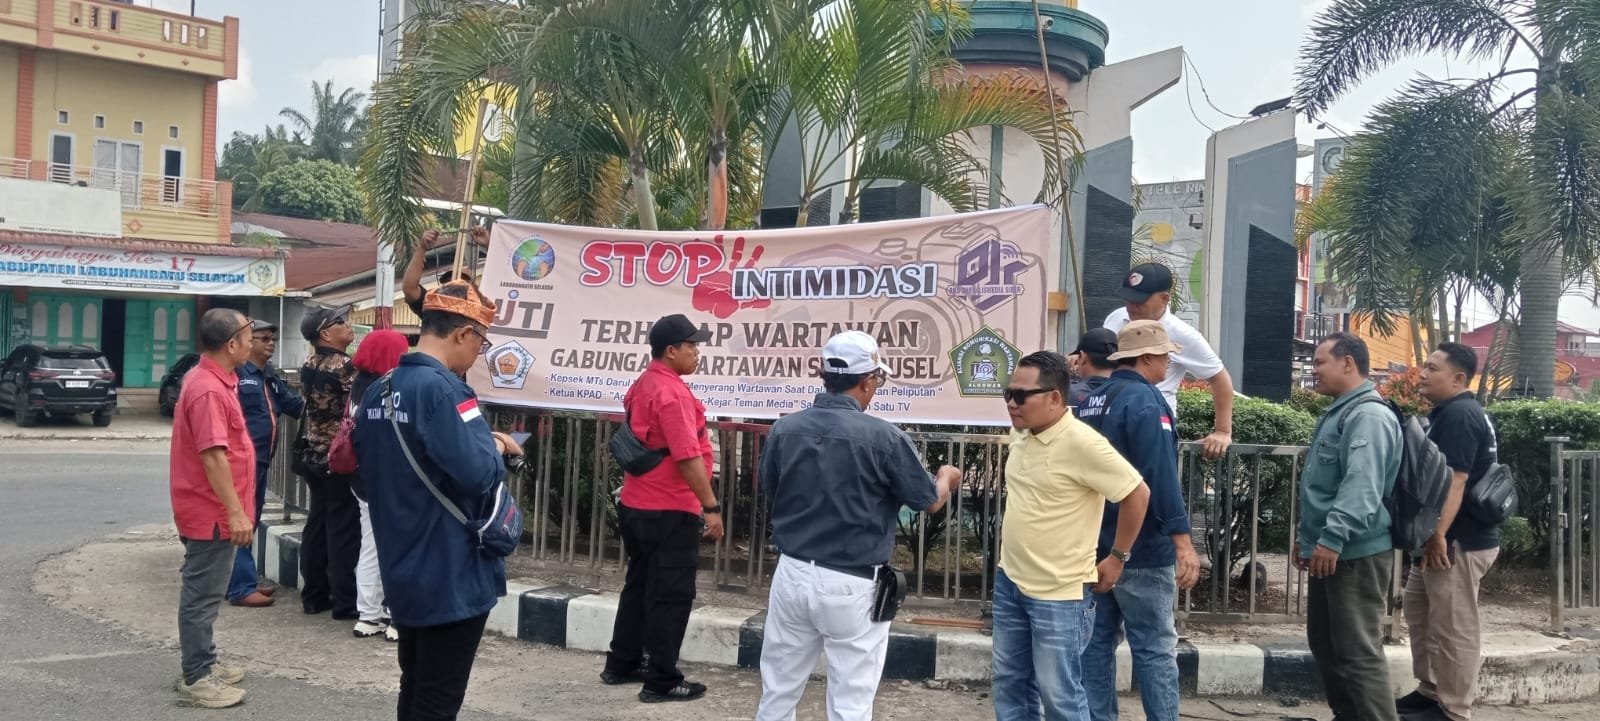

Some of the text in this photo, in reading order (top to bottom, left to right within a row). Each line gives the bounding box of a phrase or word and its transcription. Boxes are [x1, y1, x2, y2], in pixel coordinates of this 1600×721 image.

[80, 265, 186, 281] LABUHANBATU
[188, 272, 245, 283] SELATAN
[170, 256, 196, 271] 17
[580, 241, 725, 287] STOP
[732, 263, 938, 299] INTIMIDASI
[550, 373, 583, 386] Kepsek
[586, 377, 603, 385] MTs
[606, 378, 630, 386] Darul
[737, 383, 781, 393] Wartawan
[784, 385, 805, 393] Saat
[891, 387, 936, 398] Peliputan
[549, 388, 575, 398] Ketua
[577, 390, 602, 399] KPAD
[734, 398, 764, 407] Teman
[873, 402, 895, 411] Satu
[898, 402, 911, 411] TV
